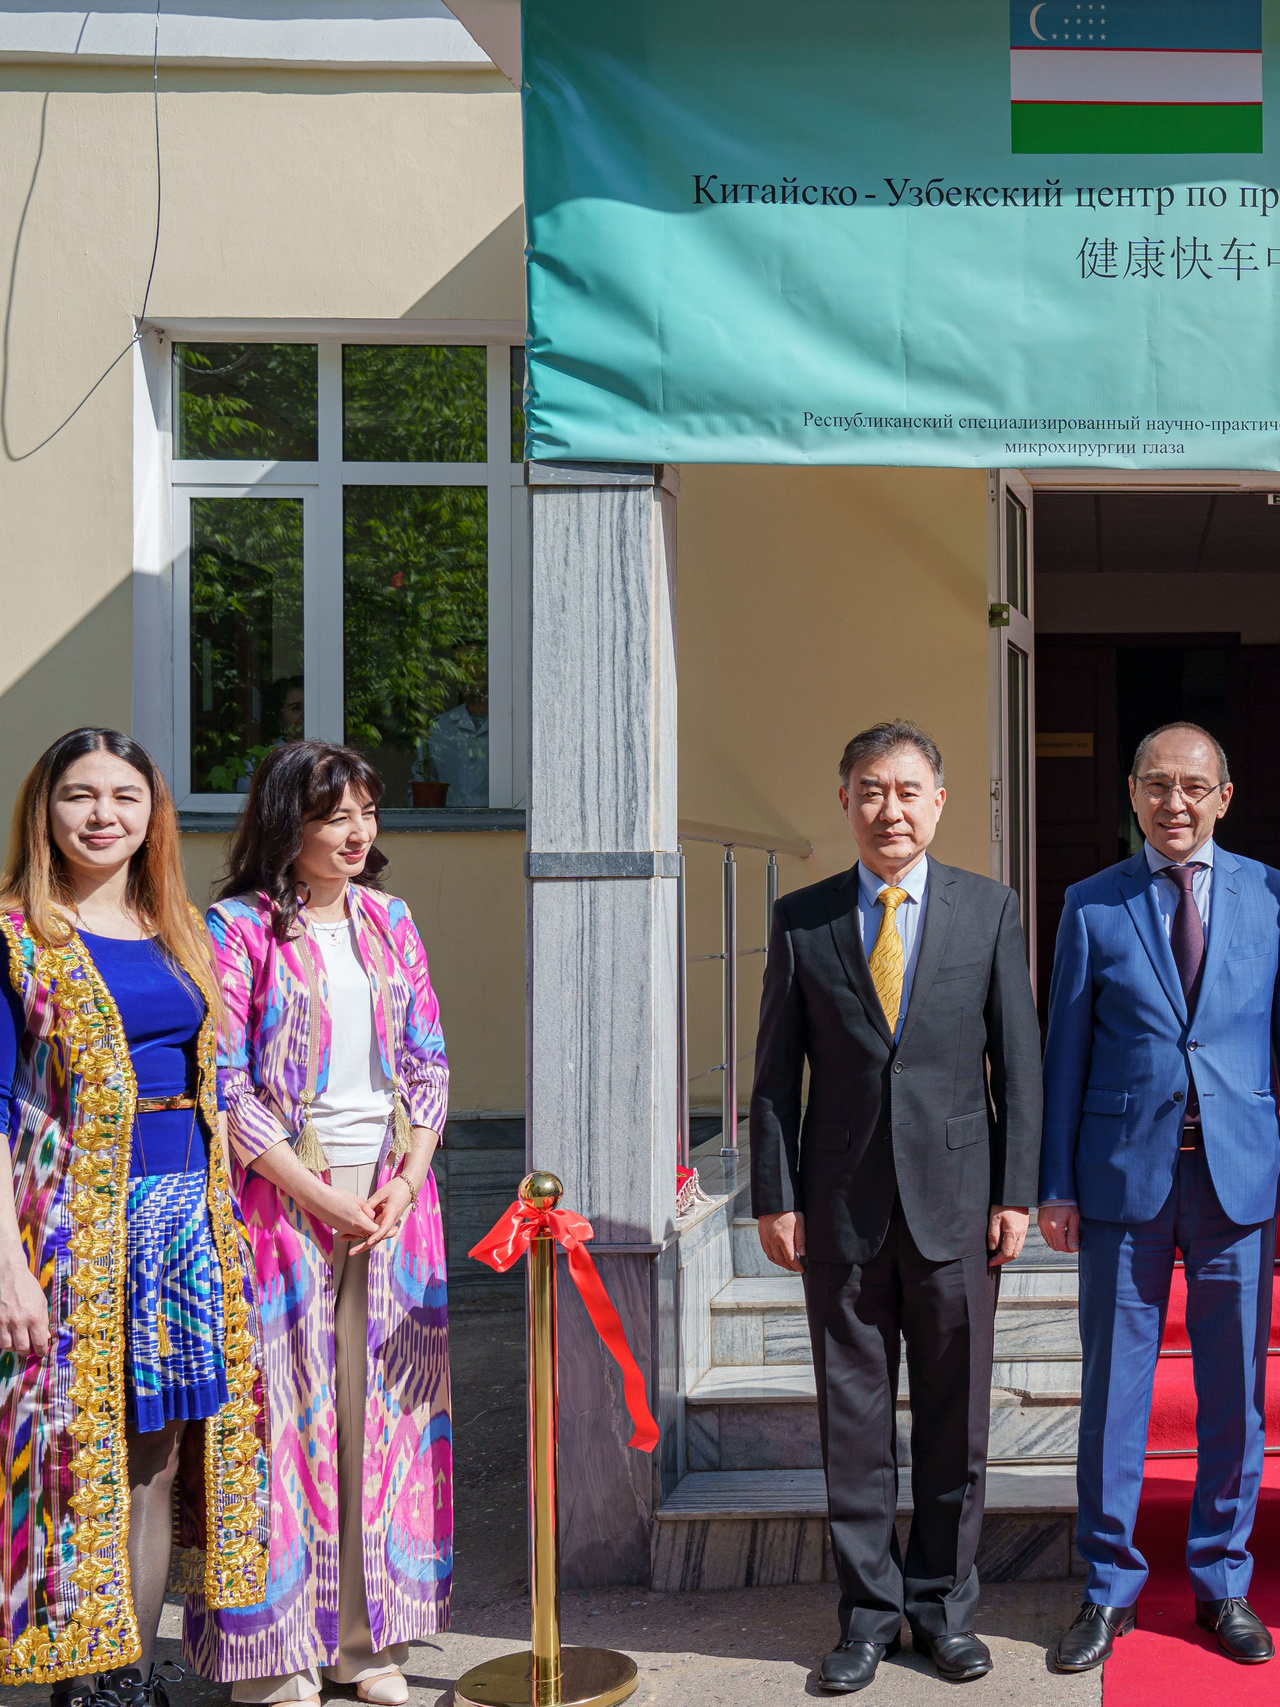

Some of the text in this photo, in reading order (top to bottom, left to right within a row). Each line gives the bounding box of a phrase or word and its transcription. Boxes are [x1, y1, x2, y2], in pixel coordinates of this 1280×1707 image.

[1074, 186, 1175, 216] центр
[1185, 186, 1228, 208] по
[802, 411, 954, 432] Республиканский
[958, 415, 1141, 436] специализированный
[1004, 442, 1185, 457] микрохирургии глаза
